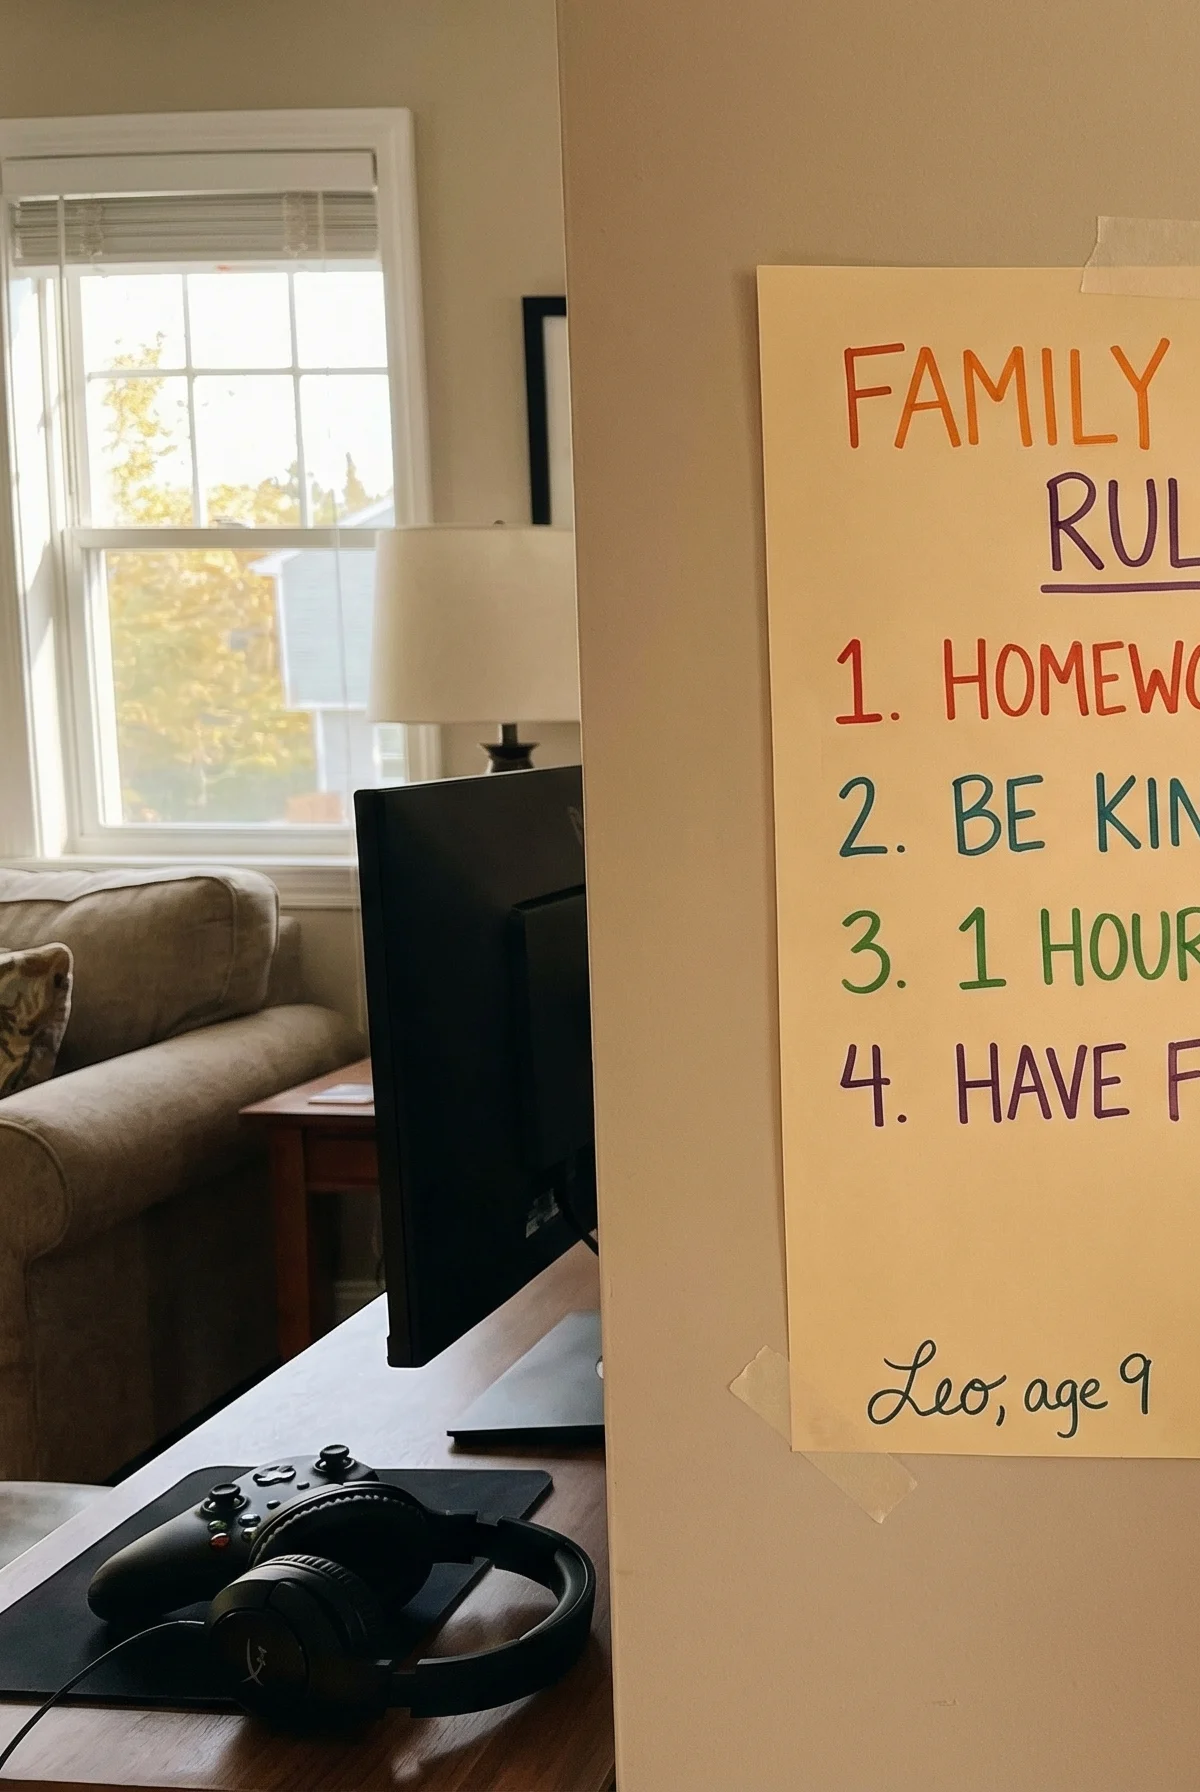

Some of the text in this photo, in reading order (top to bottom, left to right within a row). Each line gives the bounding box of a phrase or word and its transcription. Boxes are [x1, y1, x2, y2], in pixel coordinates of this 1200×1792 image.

[842, 337, 1171, 451] FAMILY
[835, 638, 900, 725] 1.
[838, 776, 906, 858] 2.
[951, 773, 1046, 857] BE
[841, 909, 907, 995] 3.
[958, 906, 1007, 991] 1
[839, 1043, 908, 1129] 4.
[954, 1042, 1131, 1125] HAVE
[867, 1339, 1153, 1439] Leo, age 9
